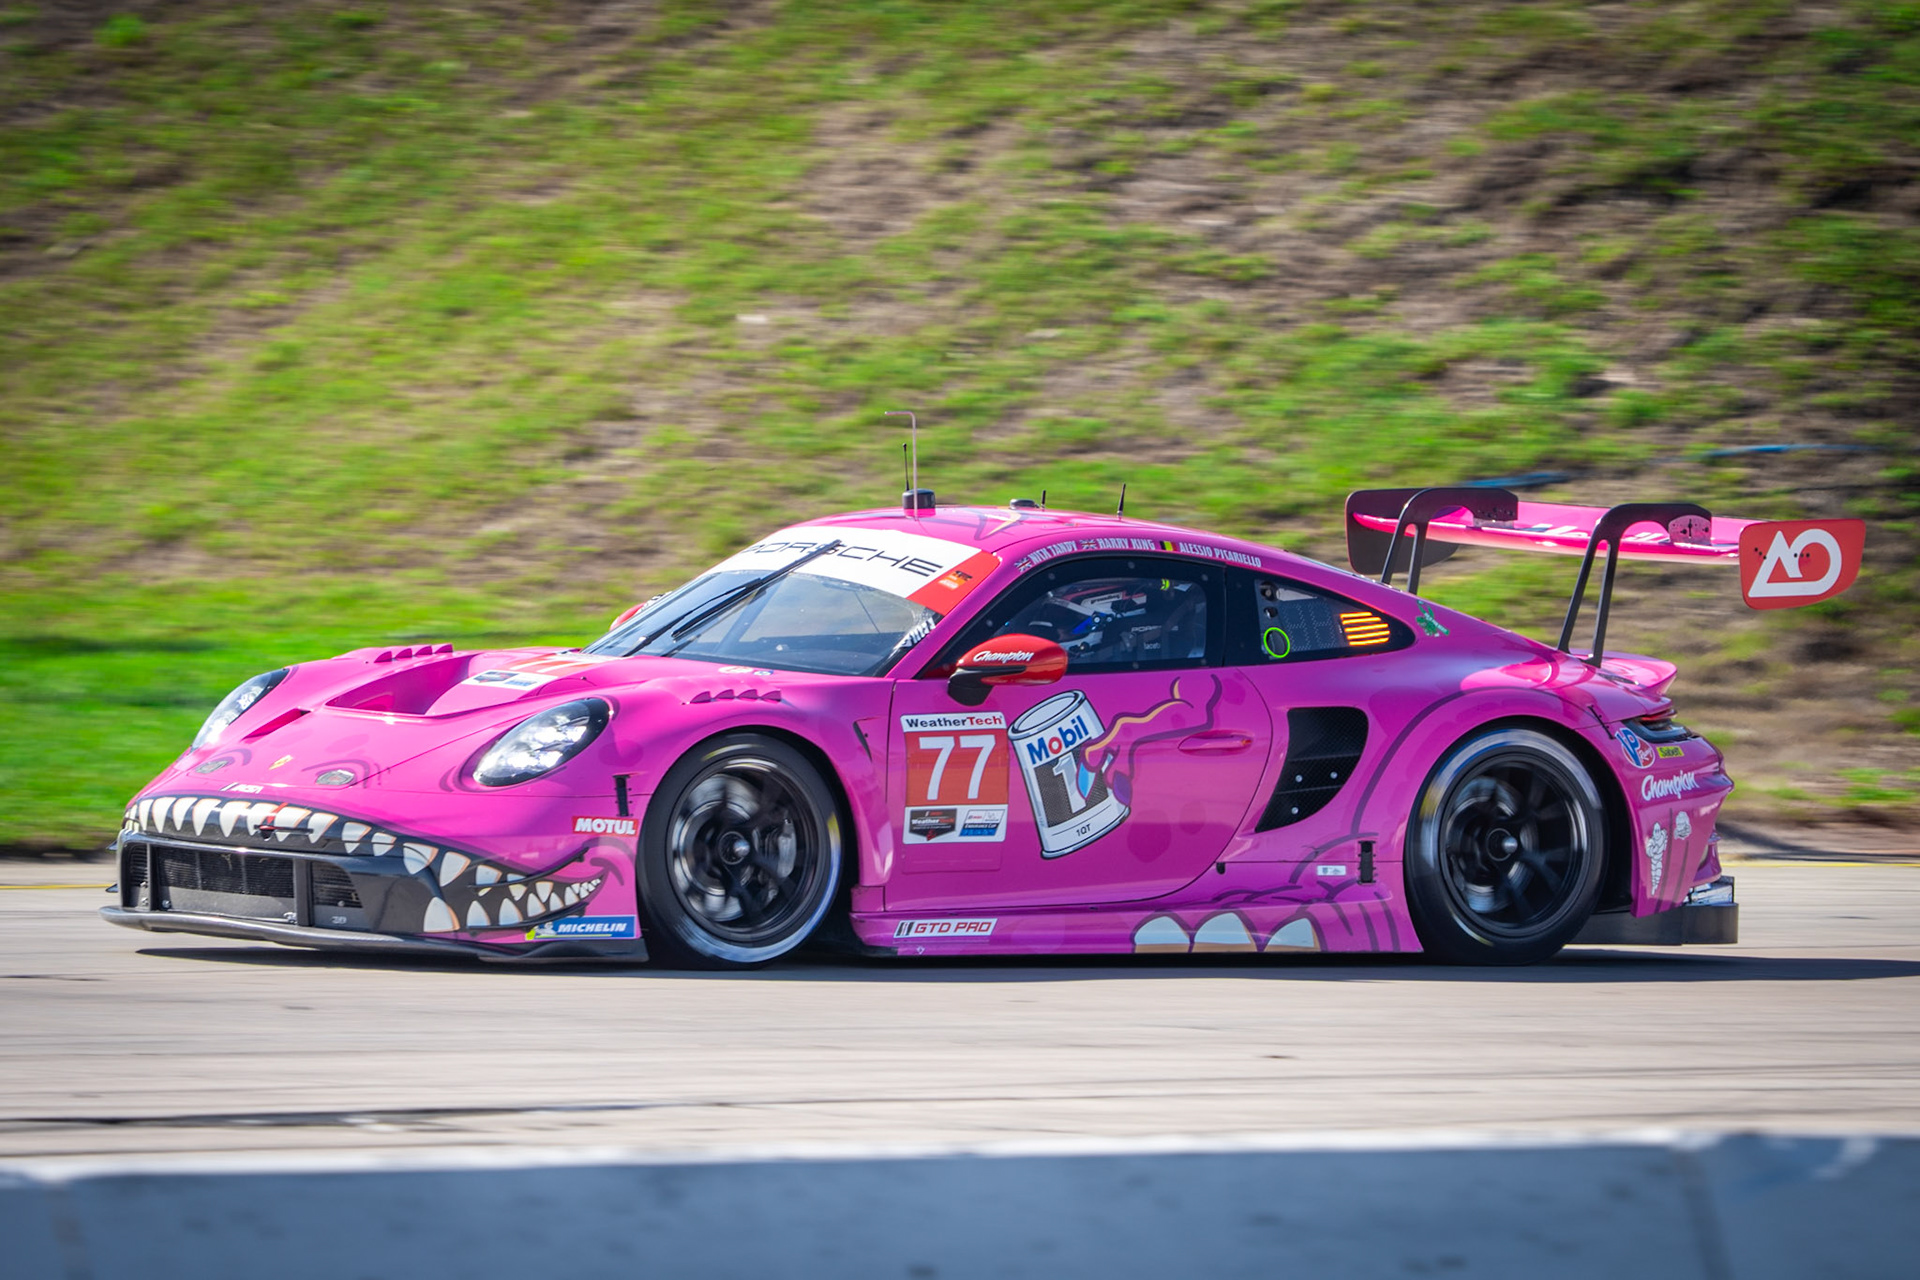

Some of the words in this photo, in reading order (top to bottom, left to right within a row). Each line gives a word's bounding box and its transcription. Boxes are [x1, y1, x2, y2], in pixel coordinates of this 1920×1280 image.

[1047, 540, 1077, 557] TANDY
[1096, 537, 1129, 550] HARRY
[1130, 538, 1155, 551] KING
[1179, 542, 1213, 558] ALESSIO
[1213, 547, 1262, 568] PICARIELLO
[973, 650, 1034, 664] Champion
[906, 715, 1003, 728] WeatherTech
[1026, 714, 1089, 765] Mobil
[918, 734, 996, 801] 77
[1052, 751, 1087, 814] 1
[1641, 770, 1700, 801] Champion
[575, 817, 636, 835] MOTUL
[1076, 823, 1091, 838] 1QT
[557, 922, 628, 933] MICHELIN
[954, 921, 992, 934] PRO
